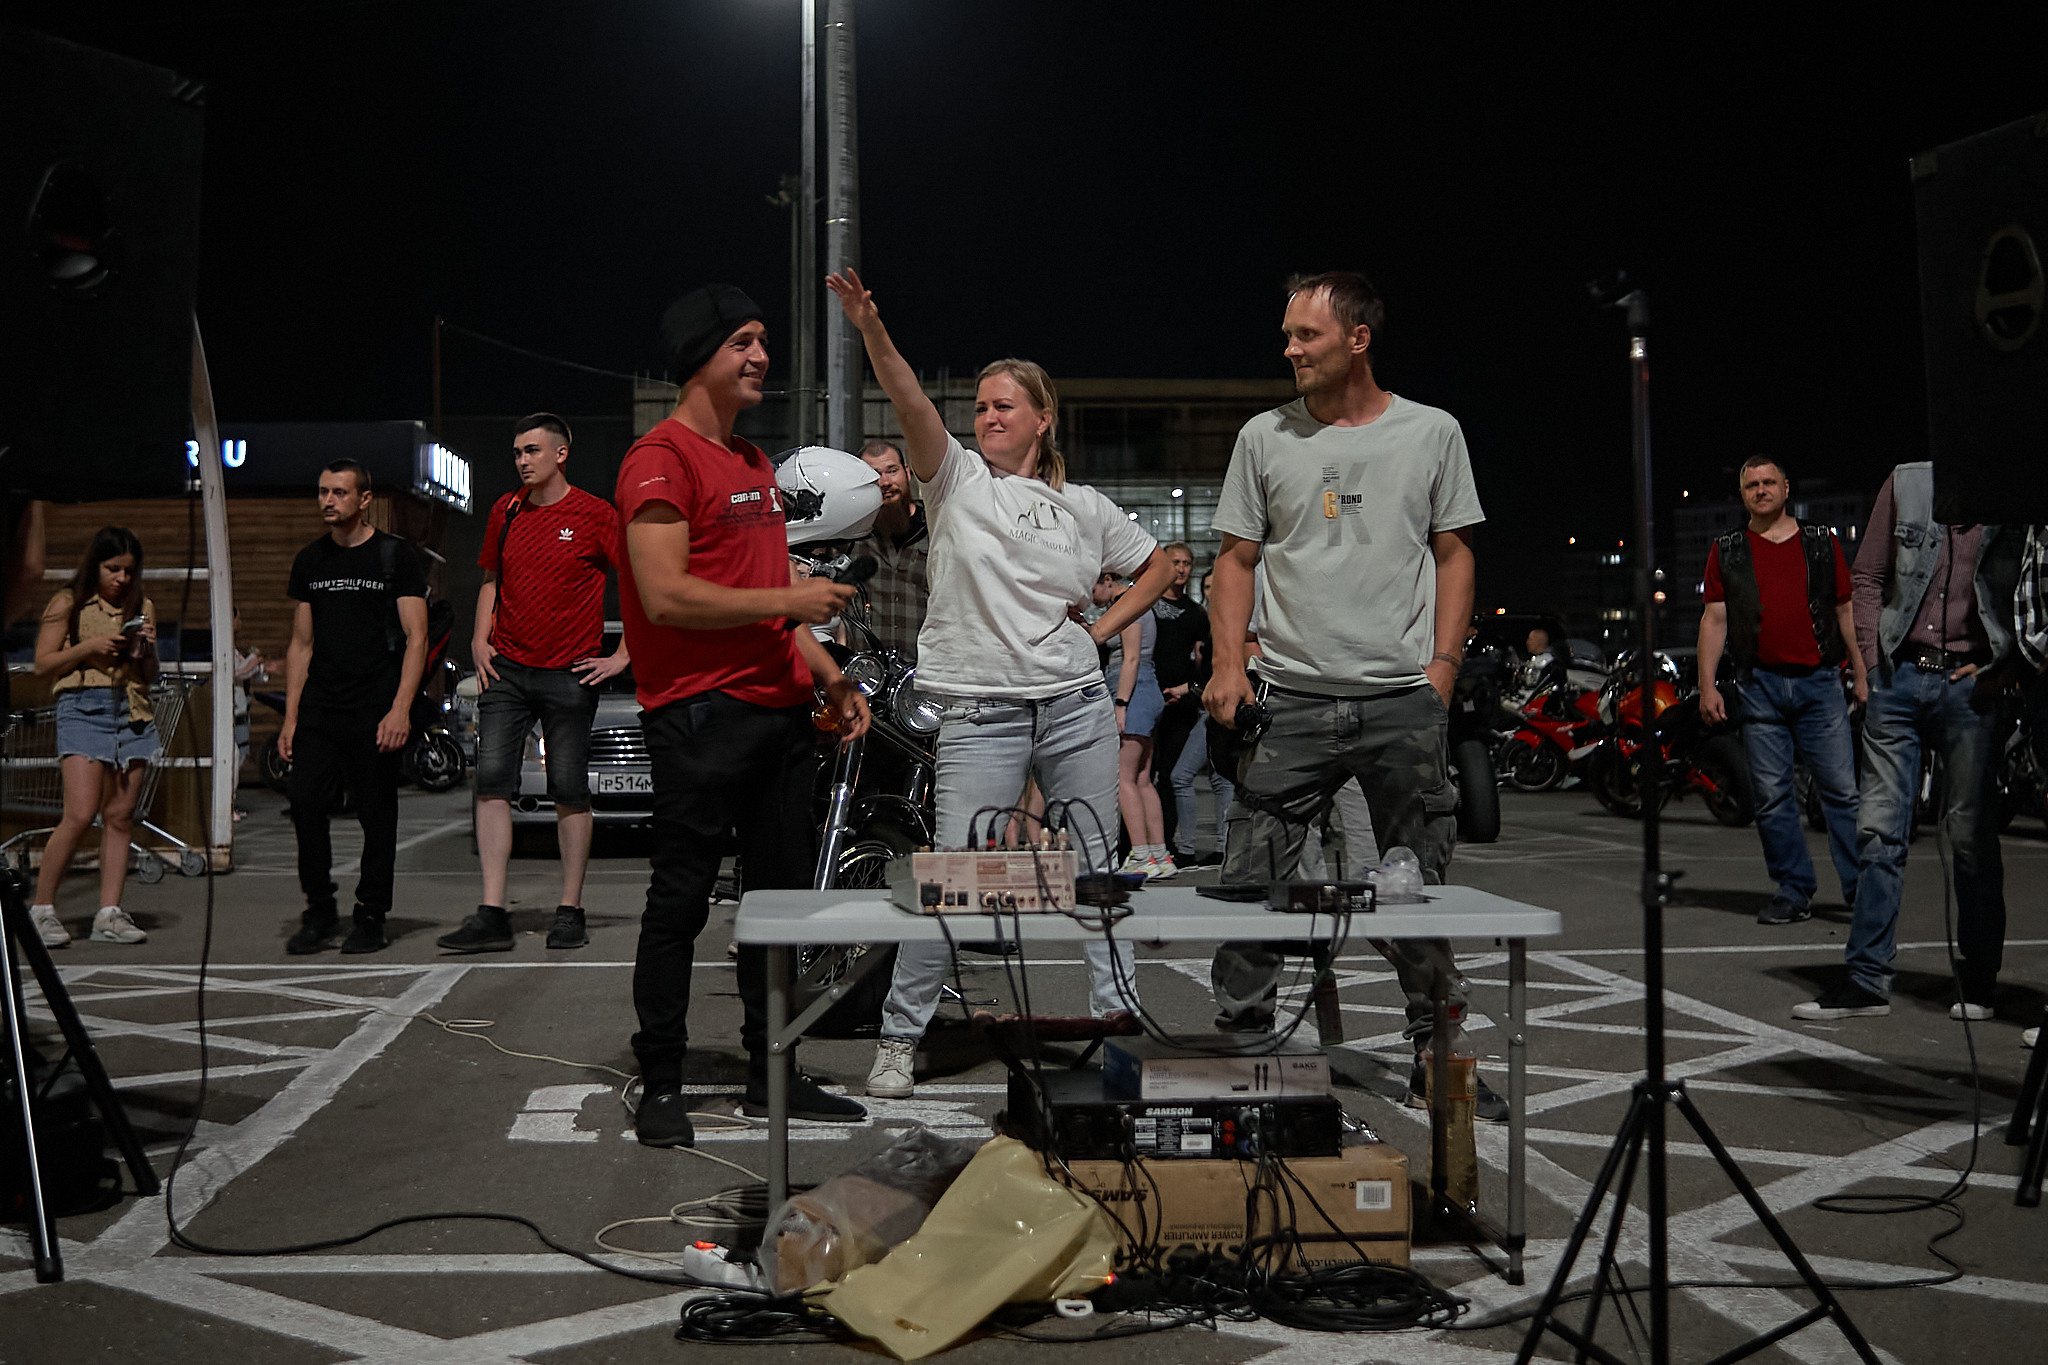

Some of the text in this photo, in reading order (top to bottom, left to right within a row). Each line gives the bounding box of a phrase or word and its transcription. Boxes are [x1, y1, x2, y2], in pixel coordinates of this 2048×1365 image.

[308, 580, 336, 590] TOMMY
[344, 577, 384, 591] HILFIGER
[1145, 1107, 1193, 1117] SAMSON
[1163, 1230, 1243, 1240] POWER AMPLIFIER
